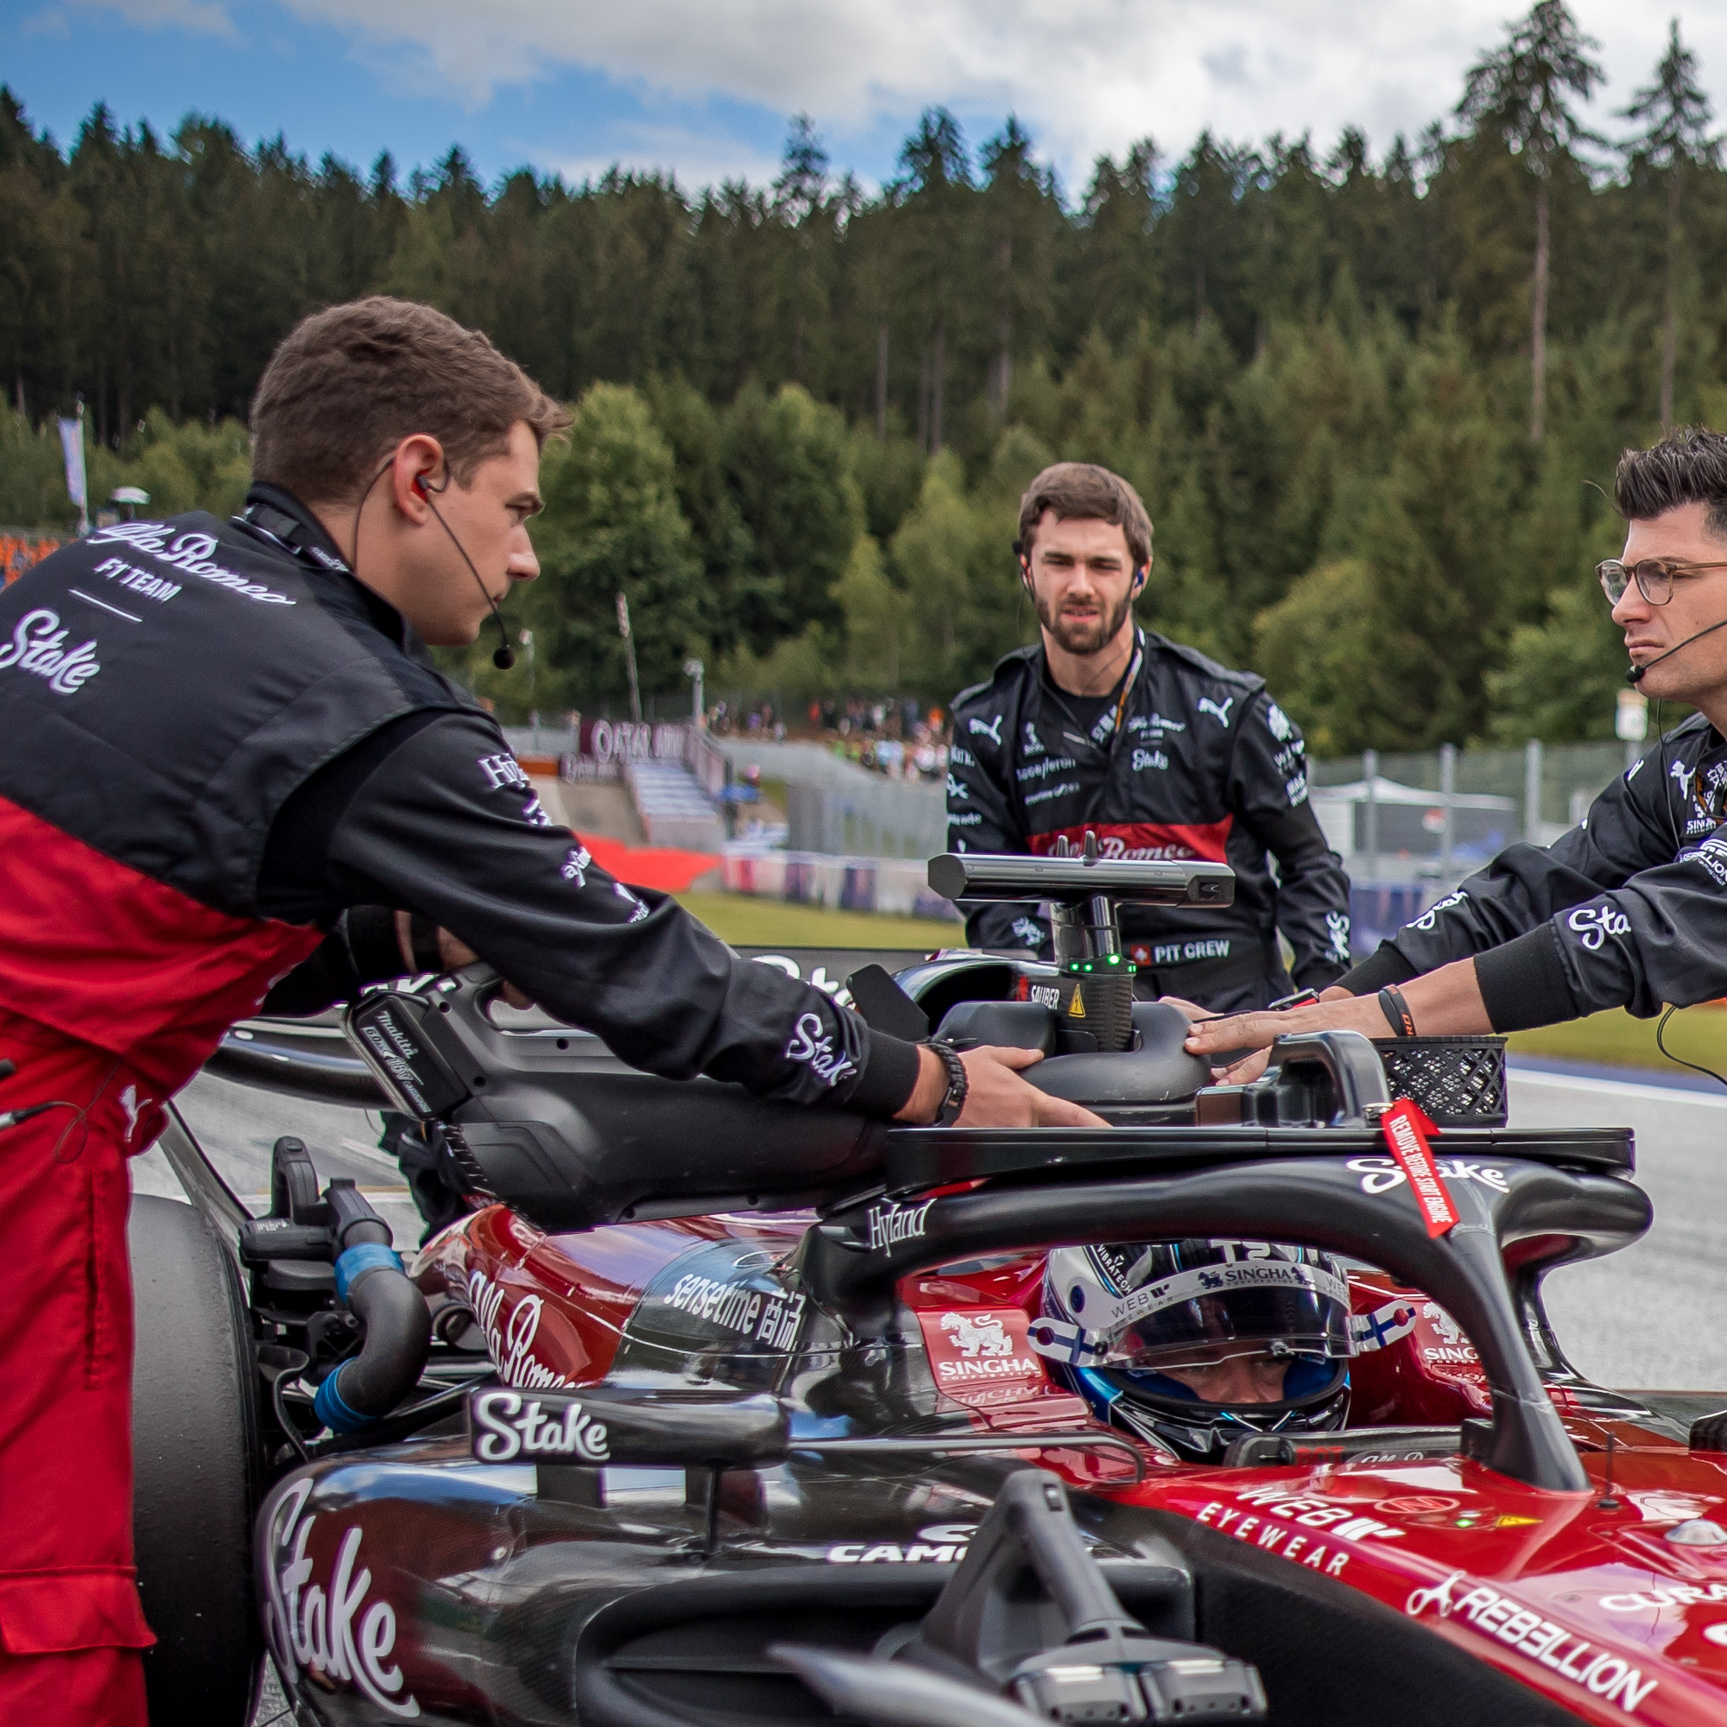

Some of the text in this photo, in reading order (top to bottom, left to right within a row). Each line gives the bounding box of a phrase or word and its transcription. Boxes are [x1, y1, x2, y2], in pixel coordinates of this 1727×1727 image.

[93, 557, 183, 603] F1 TEAM
[154, 533, 297, 605] Romeo
[0, 608, 101, 694] Stake
[1153, 939, 1231, 964] PIT CREW
[1568, 905, 1632, 950] Sta
[1030, 983, 1061, 1011] SAUBER
[1346, 1157, 1511, 1195] Sake
[1388, 1113, 1455, 1225] REMOVE BEFORE START ENGINE
[868, 1197, 939, 1259] Hyland
[1096, 1242, 1135, 1296] VIBRATECH
[1224, 1267, 1292, 1282] SINGHA
[664, 1273, 763, 1335] sensetime
[1110, 1292, 1149, 1320] WEB
[500, 1293, 586, 1388] Rome
[938, 1359, 1039, 1376] SINGHA
[1422, 1346, 1481, 1361] SING
[473, 1391, 611, 1461] Stake
[1236, 1487, 1353, 1528] WEB
[1196, 1501, 1350, 1577] EYEWEAR
[262, 1476, 422, 1719] Stake
[1453, 1586, 1658, 1713] REBELLION
